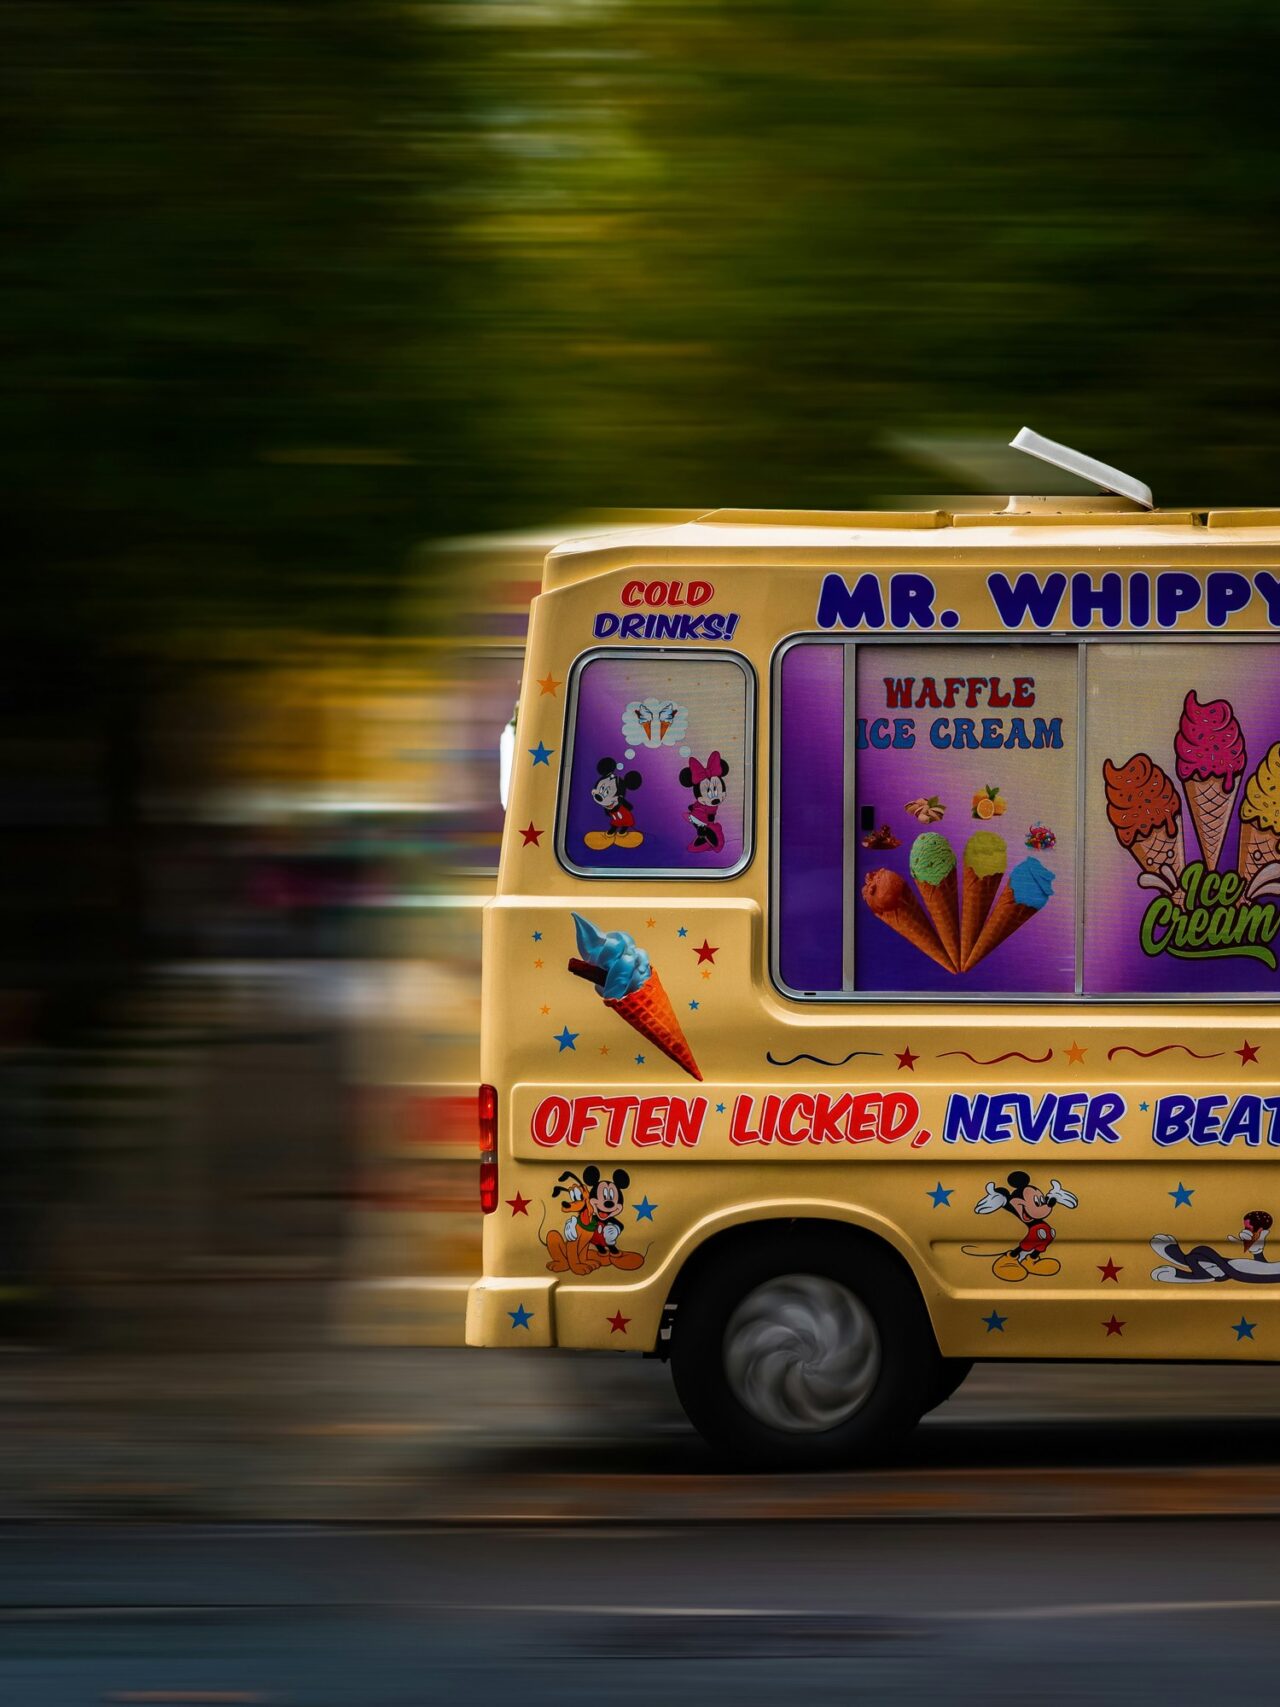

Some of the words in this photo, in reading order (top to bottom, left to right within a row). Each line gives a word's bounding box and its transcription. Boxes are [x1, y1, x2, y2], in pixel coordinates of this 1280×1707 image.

[621, 580, 714, 608] COLD
[816, 571, 961, 630] MR.
[592, 612, 740, 641] DRINKS!
[883, 677, 1036, 709] WAFFLE
[856, 717, 915, 749] ICE
[929, 717, 1064, 749] CREAM
[1179, 861, 1242, 911] Ice
[531, 1094, 708, 1148] OFTEN
[729, 1091, 933, 1149] LICKED,
[943, 1091, 1127, 1146] NEVER
